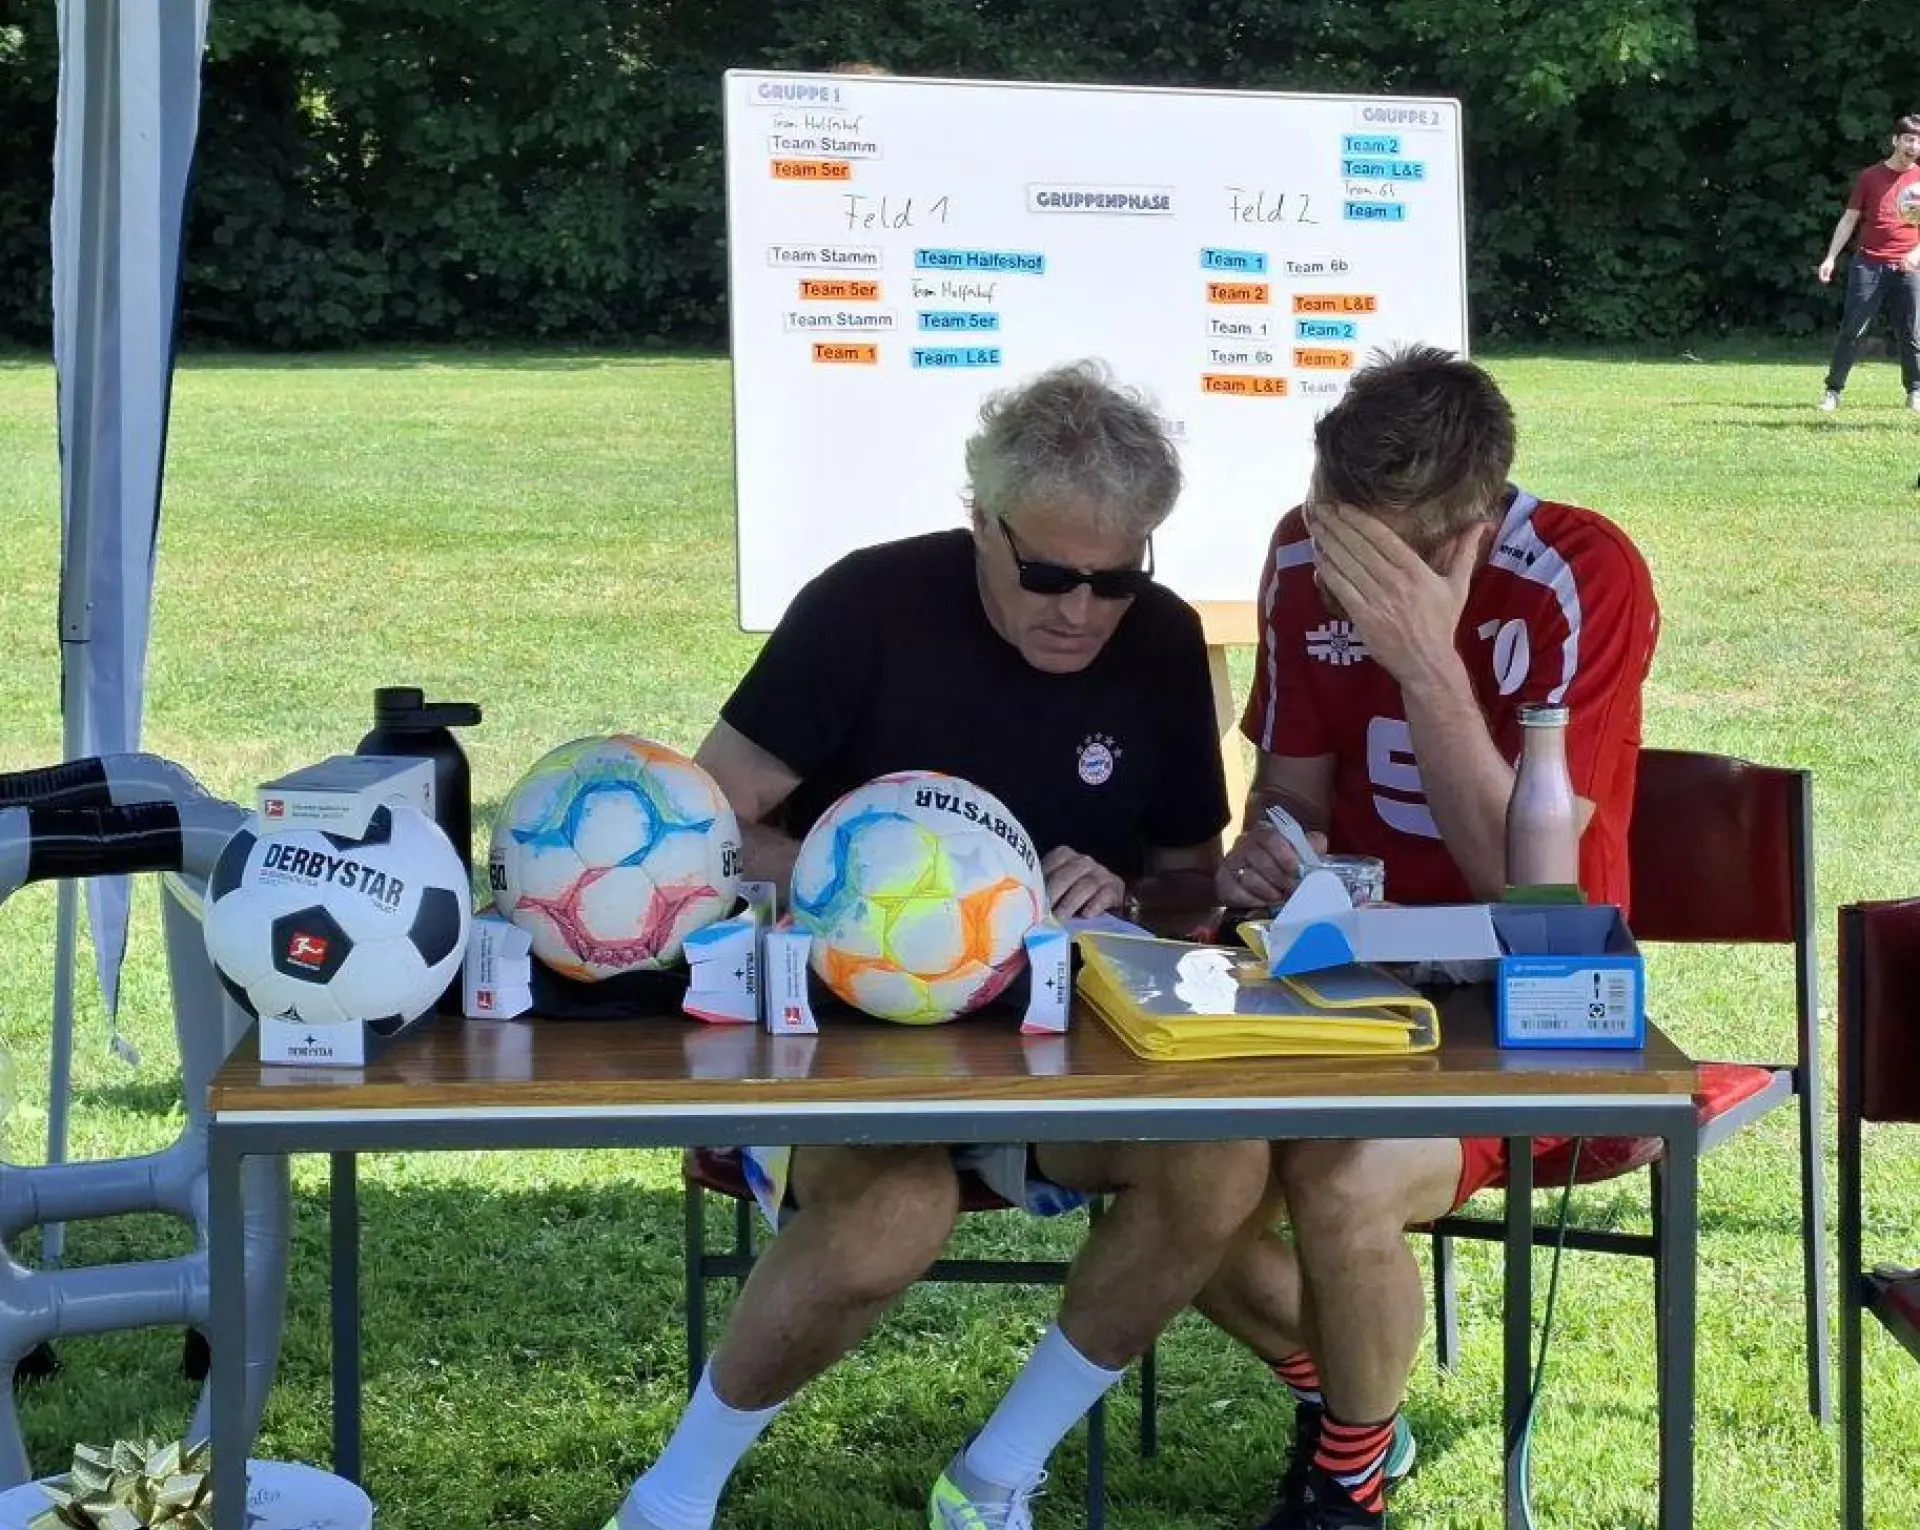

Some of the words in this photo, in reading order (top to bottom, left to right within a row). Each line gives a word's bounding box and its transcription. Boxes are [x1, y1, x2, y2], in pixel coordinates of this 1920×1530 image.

[757, 83, 830, 101] GRUPPE
[772, 135, 815, 149] Team
[821, 137, 877, 153] Stamm
[1345, 136, 1385, 151] Team
[1389, 139, 1398, 154] 2
[774, 162, 817, 176] Team
[821, 162, 849, 176] 5er
[1343, 160, 1385, 175] Team
[1391, 163, 1423, 178] L&E
[1035, 190, 1171, 211] GRUPPENPHASE
[1223, 185, 1286, 223] Feld
[1297, 193, 1320, 224] 2
[841, 193, 915, 232] Feld
[927, 195, 949, 224] 1
[1346, 203, 1388, 217] Team
[772, 246, 817, 262] Team
[820, 248, 878, 264] Stamm
[919, 250, 962, 265] Team
[966, 253, 1042, 269] Halfeshof
[1206, 250, 1247, 268] Team
[1287, 261, 1324, 273] Team
[1330, 259, 1349, 272] 6b
[800, 282, 845, 296] Team
[849, 282, 876, 296] 5er
[1209, 285, 1250, 301] Team
[1254, 286, 1264, 300] 2
[1295, 297, 1336, 311] Team
[1343, 296, 1376, 311] L&E
[789, 311, 832, 327] Team
[836, 311, 893, 326] Stamm
[921, 313, 964, 328] Team
[968, 313, 996, 328] 5er
[1210, 319, 1252, 335] Team
[1300, 321, 1339, 337] Team
[1343, 323, 1353, 338] 2
[815, 345, 859, 359] Team
[914, 351, 958, 366] Team
[966, 349, 1000, 363] L&E
[1210, 349, 1248, 364] Team
[1254, 351, 1273, 364] 6b
[1296, 351, 1336, 366] Team
[1341, 351, 1350, 366] 2
[1203, 376, 1245, 392] Team
[1253, 379, 1286, 393] L&E
[916, 789, 1036, 872] DERBYSTAR
[263, 843, 405, 907] DERBYSTAR
